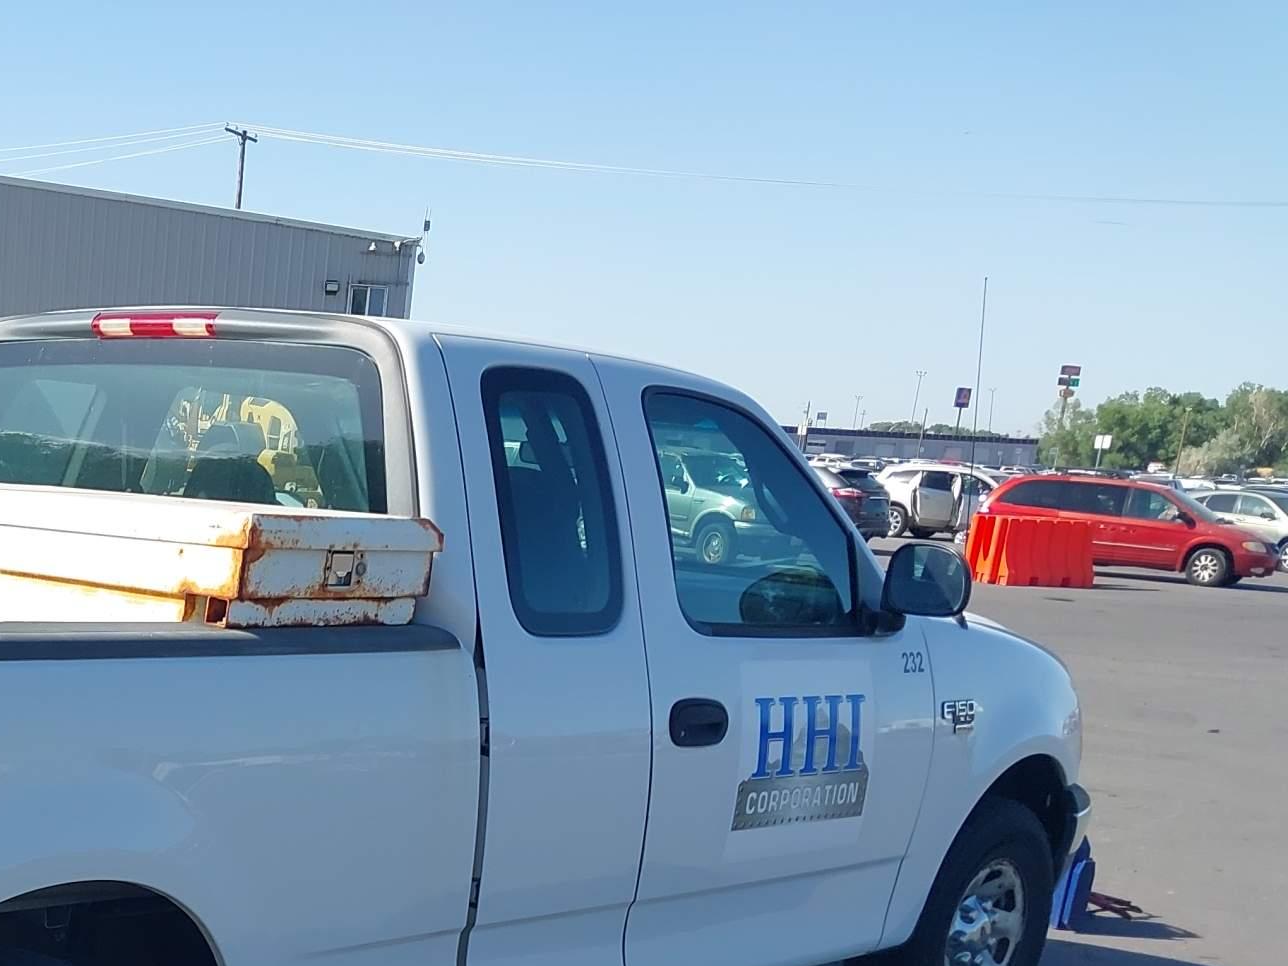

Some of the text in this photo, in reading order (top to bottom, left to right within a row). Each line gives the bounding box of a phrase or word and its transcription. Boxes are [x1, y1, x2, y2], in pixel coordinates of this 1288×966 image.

[902, 651, 925, 673] 232
[751, 694, 865, 779] HHI
[745, 782, 859, 815] CORPORATION
